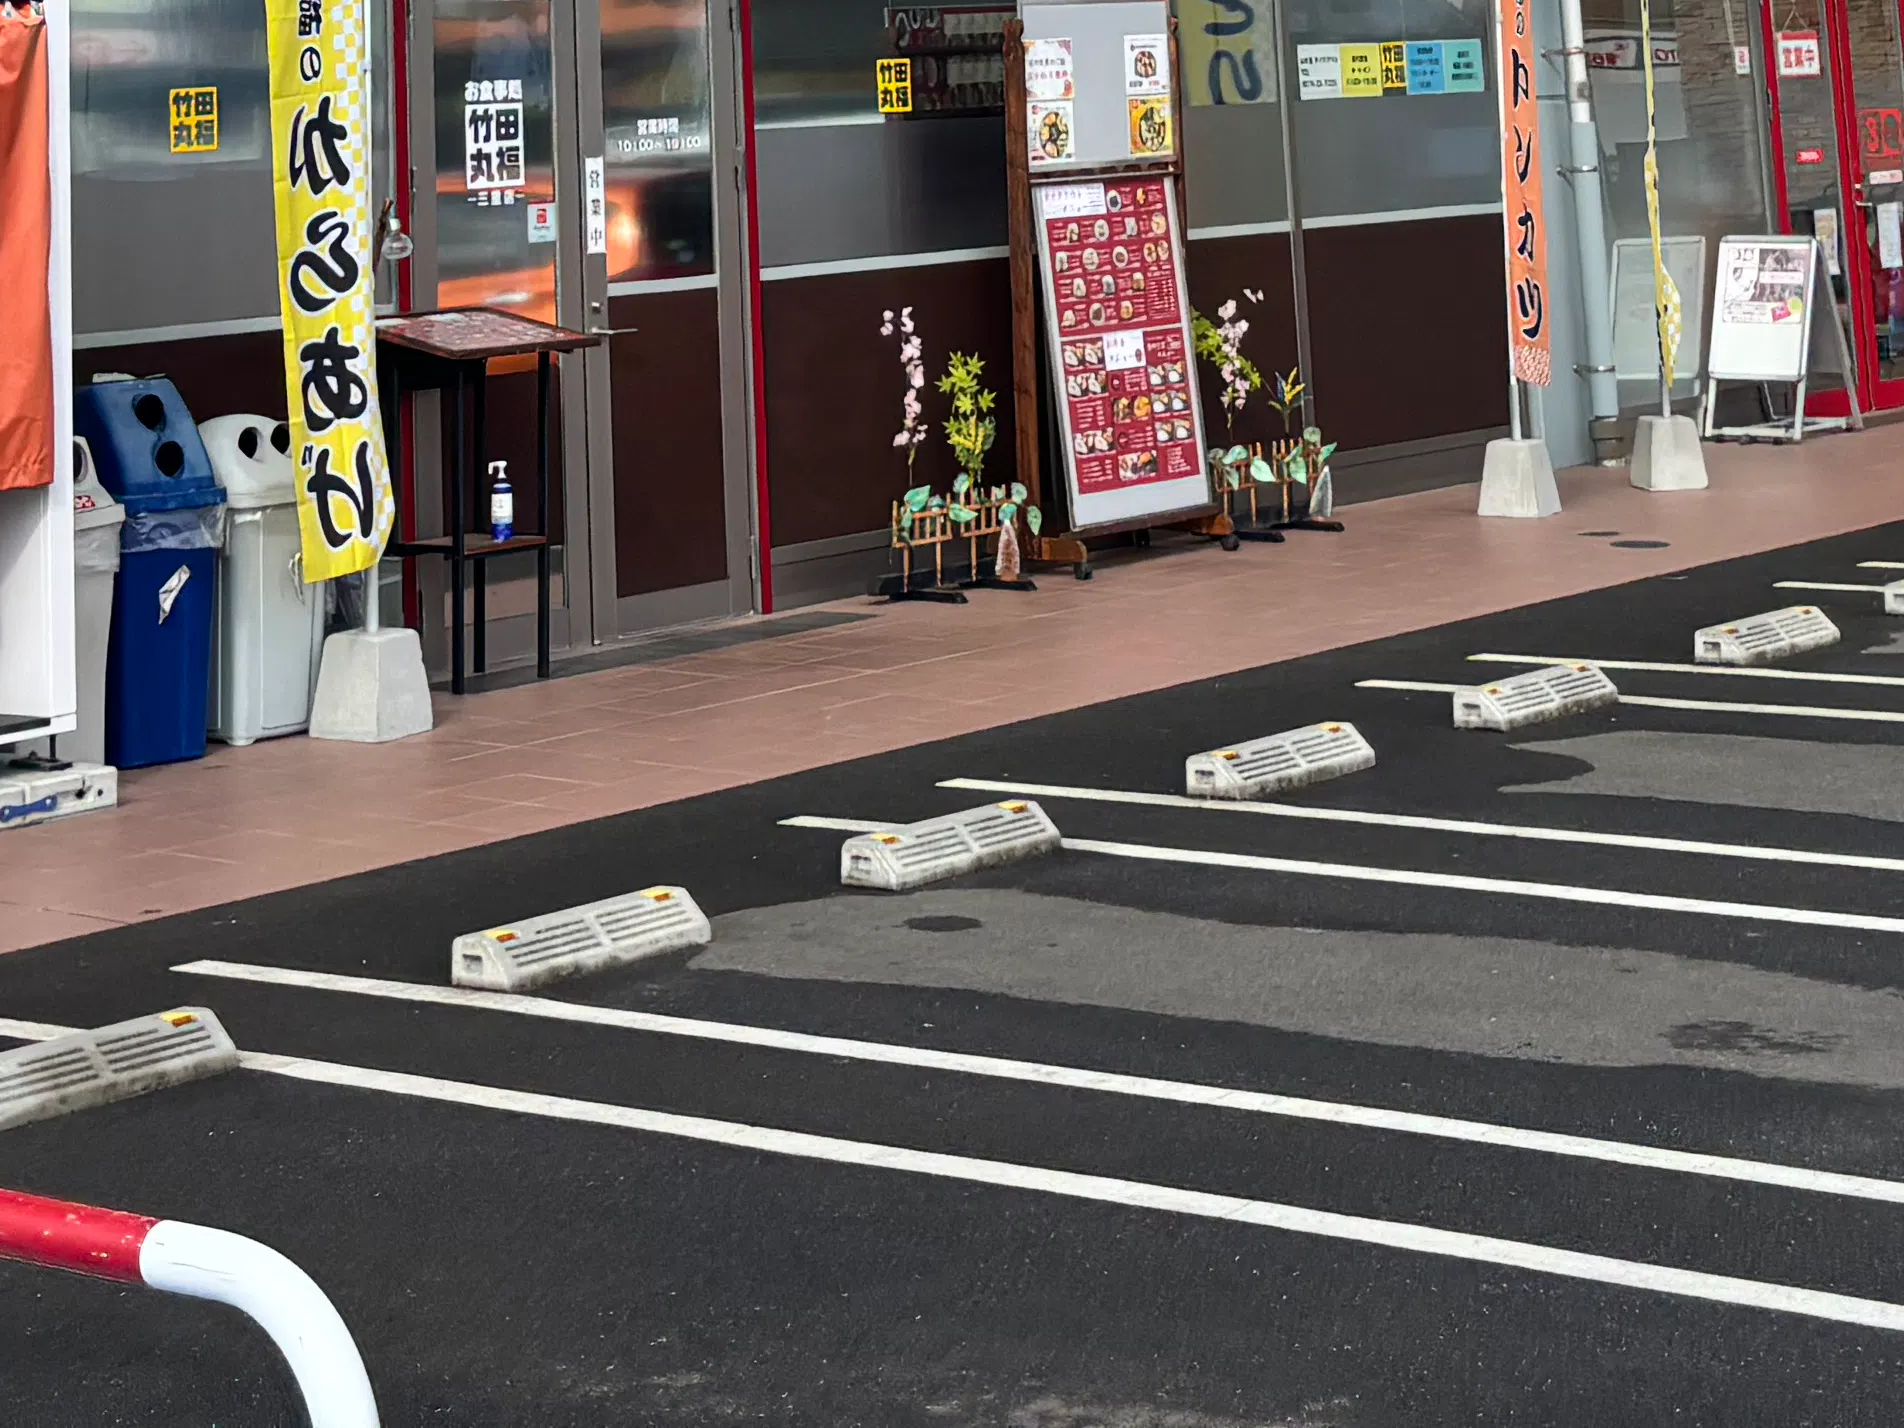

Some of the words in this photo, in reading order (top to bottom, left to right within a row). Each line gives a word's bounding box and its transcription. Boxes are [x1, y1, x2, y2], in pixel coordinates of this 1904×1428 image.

[879, 62, 908, 84] 竹田
[173, 91, 215, 118] 竹田
[879, 86, 909, 108] 丸福
[173, 119, 215, 148] 丸福
[468, 108, 520, 144] 竹田
[469, 146, 521, 184] 丸福
